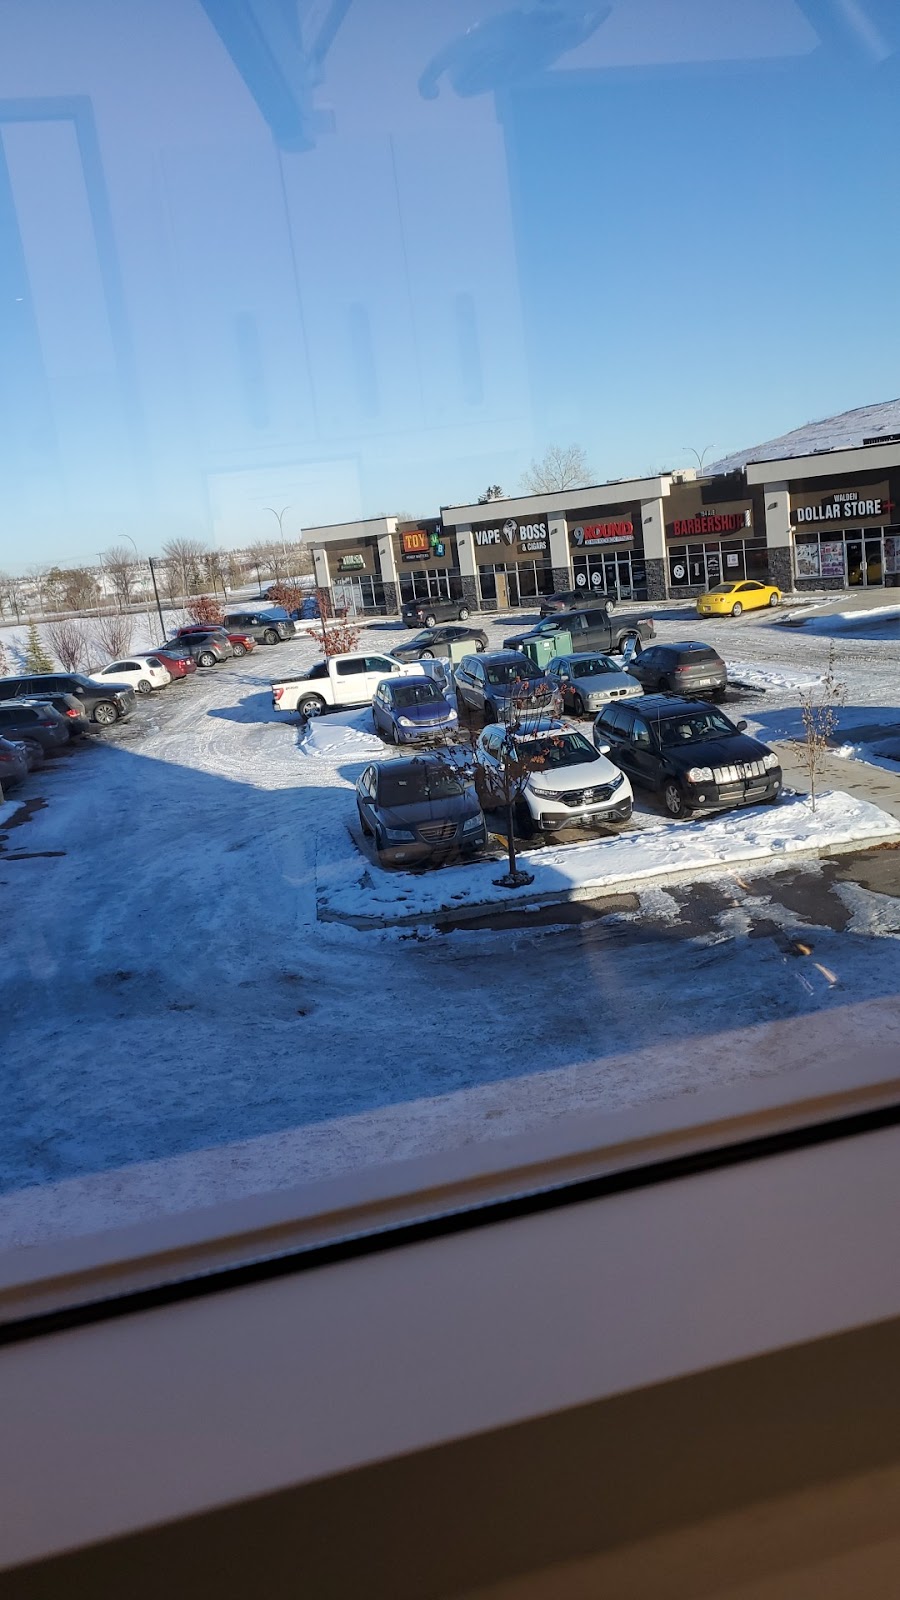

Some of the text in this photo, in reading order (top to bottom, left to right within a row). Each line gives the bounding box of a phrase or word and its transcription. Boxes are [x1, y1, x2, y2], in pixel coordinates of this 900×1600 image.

[834, 492, 858, 502] WALDEN
[797, 499, 882, 522] DOLLAR STORE
[404, 533, 425, 549] TOY
[475, 523, 547, 545] VAPE BOSS
[527, 541, 547, 551] CIGARS
